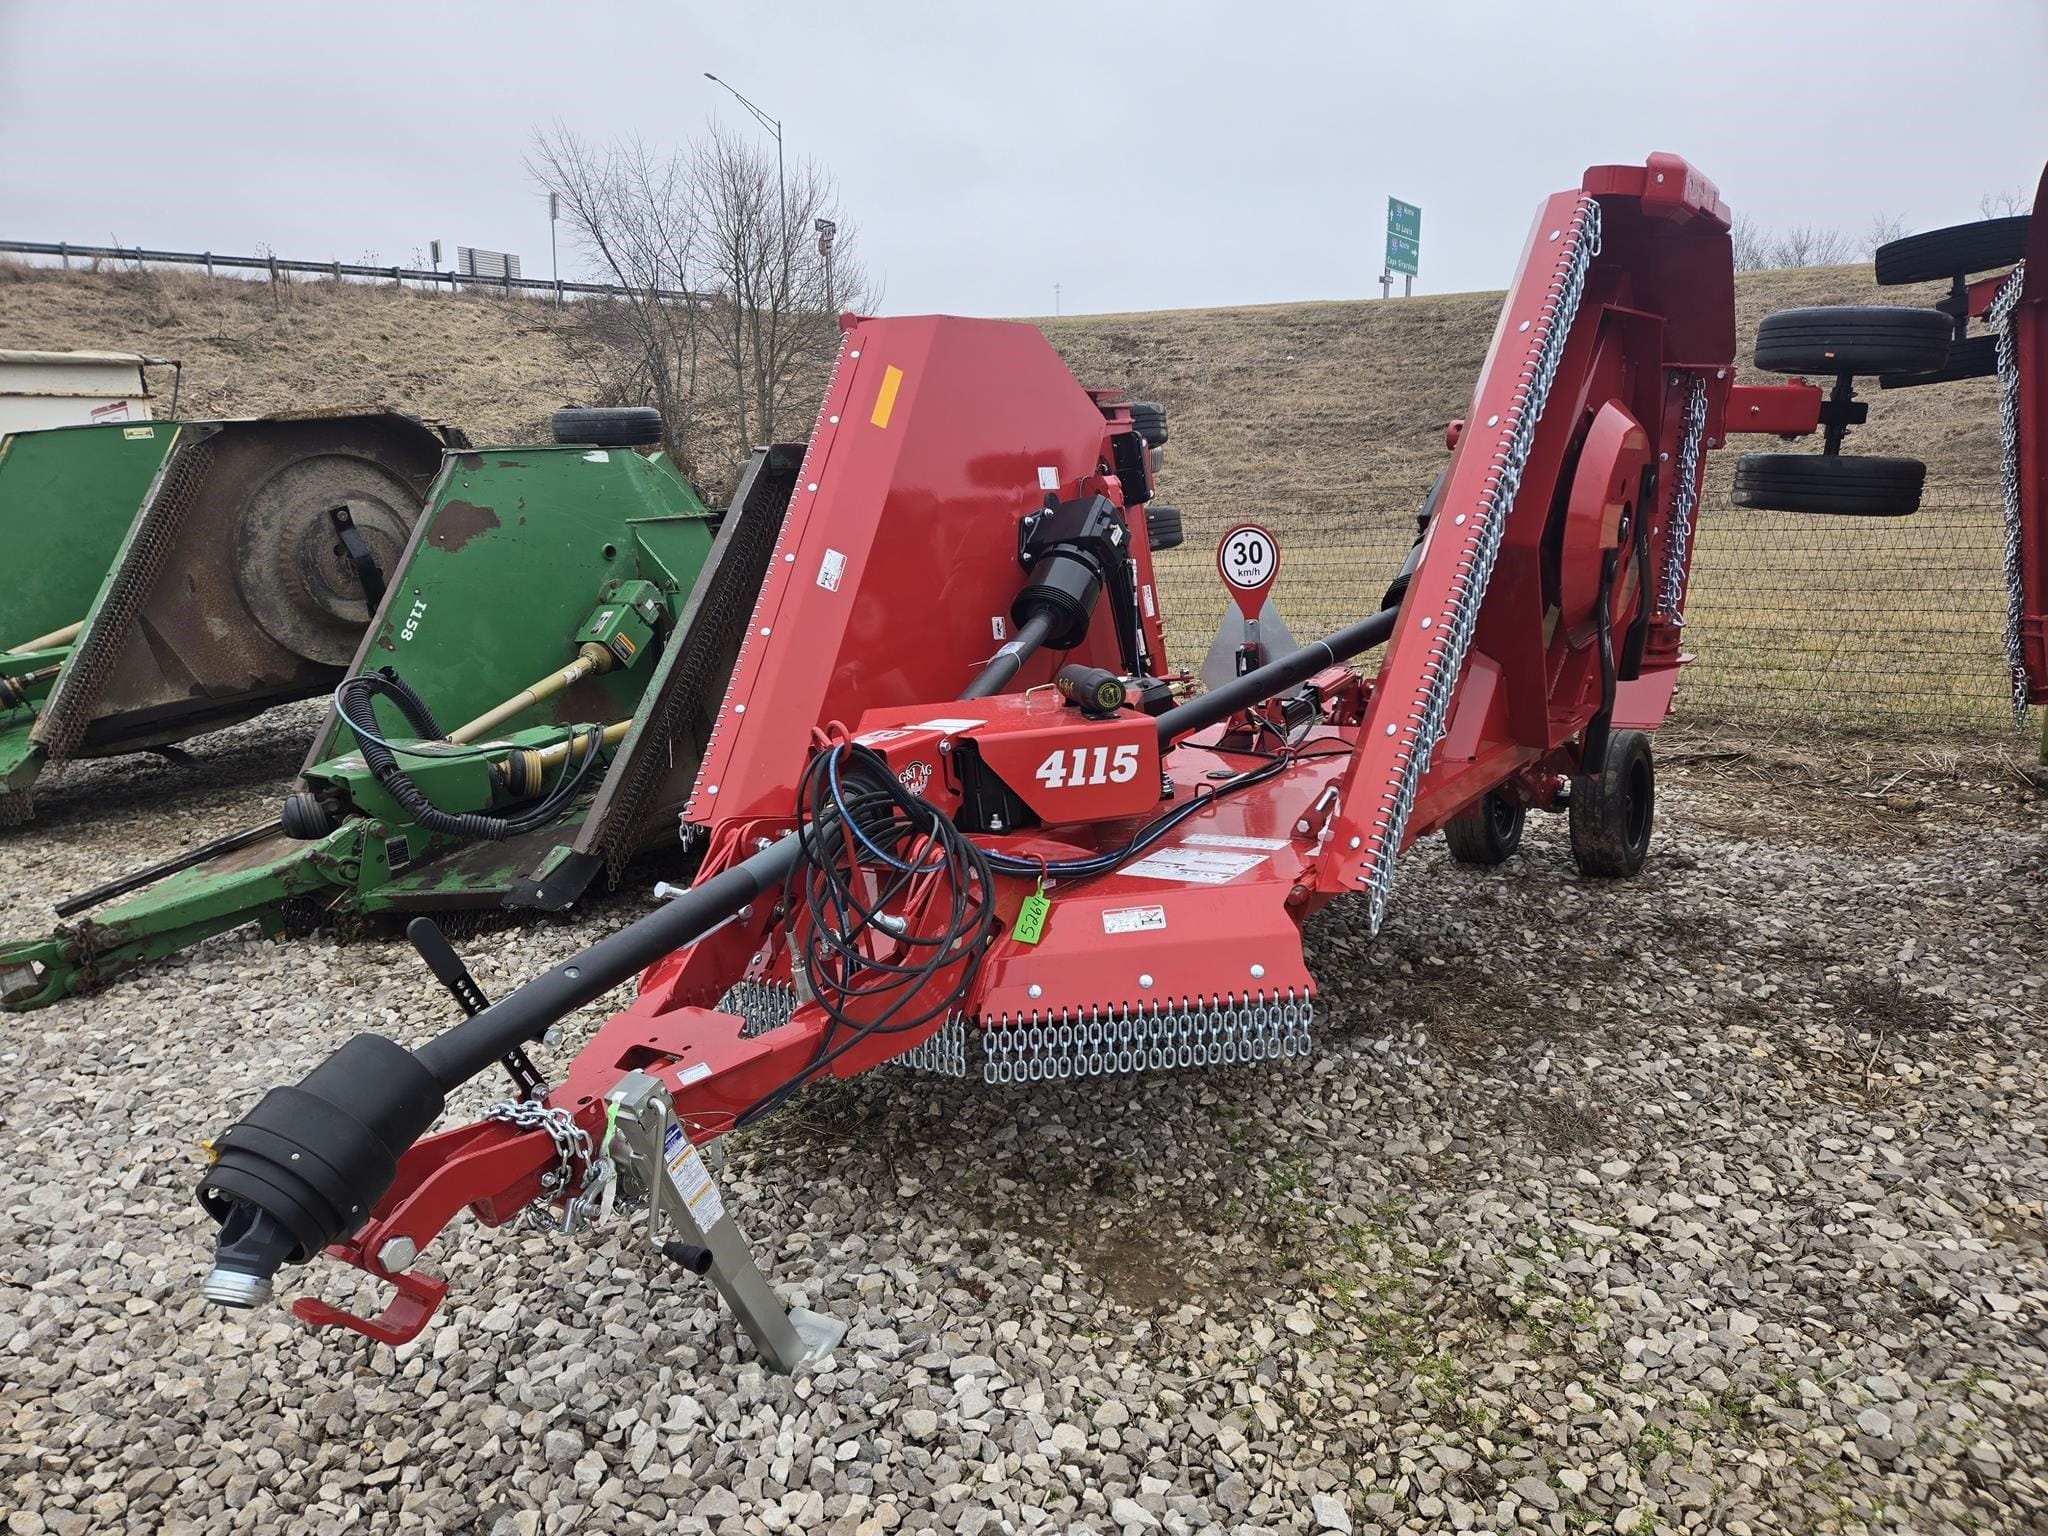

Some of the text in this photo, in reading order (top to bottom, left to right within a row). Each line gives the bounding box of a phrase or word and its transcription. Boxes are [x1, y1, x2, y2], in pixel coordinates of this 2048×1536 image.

[1233, 540, 1263, 566] 30
[1237, 567, 1261, 577] km/h
[919, 763, 932, 776] AG
[1035, 744, 1140, 789] 4115
[1020, 896, 1046, 938] 5264
